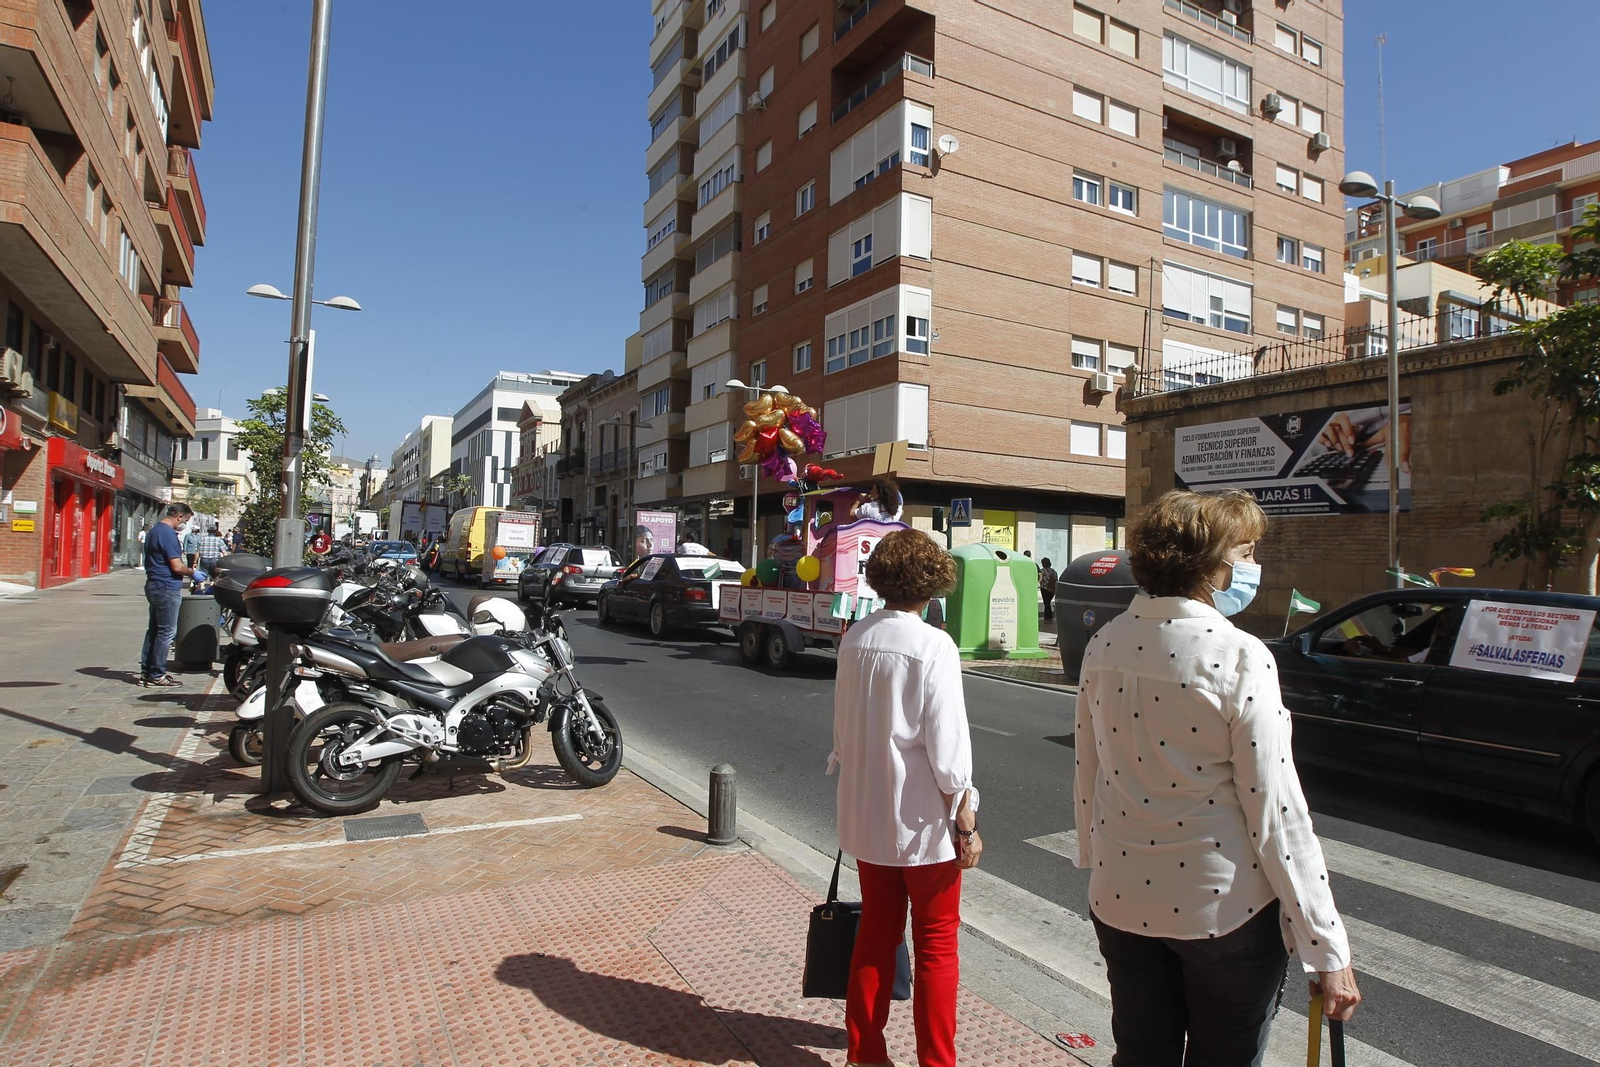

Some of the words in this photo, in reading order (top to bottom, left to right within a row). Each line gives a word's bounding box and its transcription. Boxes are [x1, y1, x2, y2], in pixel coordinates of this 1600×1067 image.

[1182, 434, 1194, 442] CICLO
[1195, 431, 1220, 440] FORMATIVO
[1221, 428, 1236, 438] GRADO
[1237, 426, 1260, 436] SUPERIOR
[1198, 440, 1223, 452] TÉCNICO
[1224, 436, 1257, 449] SUPERIOR
[1182, 450, 1233, 465] ADMINISTRACIÓN
[1235, 450, 1240, 460] Y
[1241, 446, 1275, 459] FINANZAS
[1252, 487, 1300, 502] AJARÁS
[1522, 617, 1559, 625] FUNCIONAR
[1468, 644, 1565, 668] #SALVALASFERIAS
